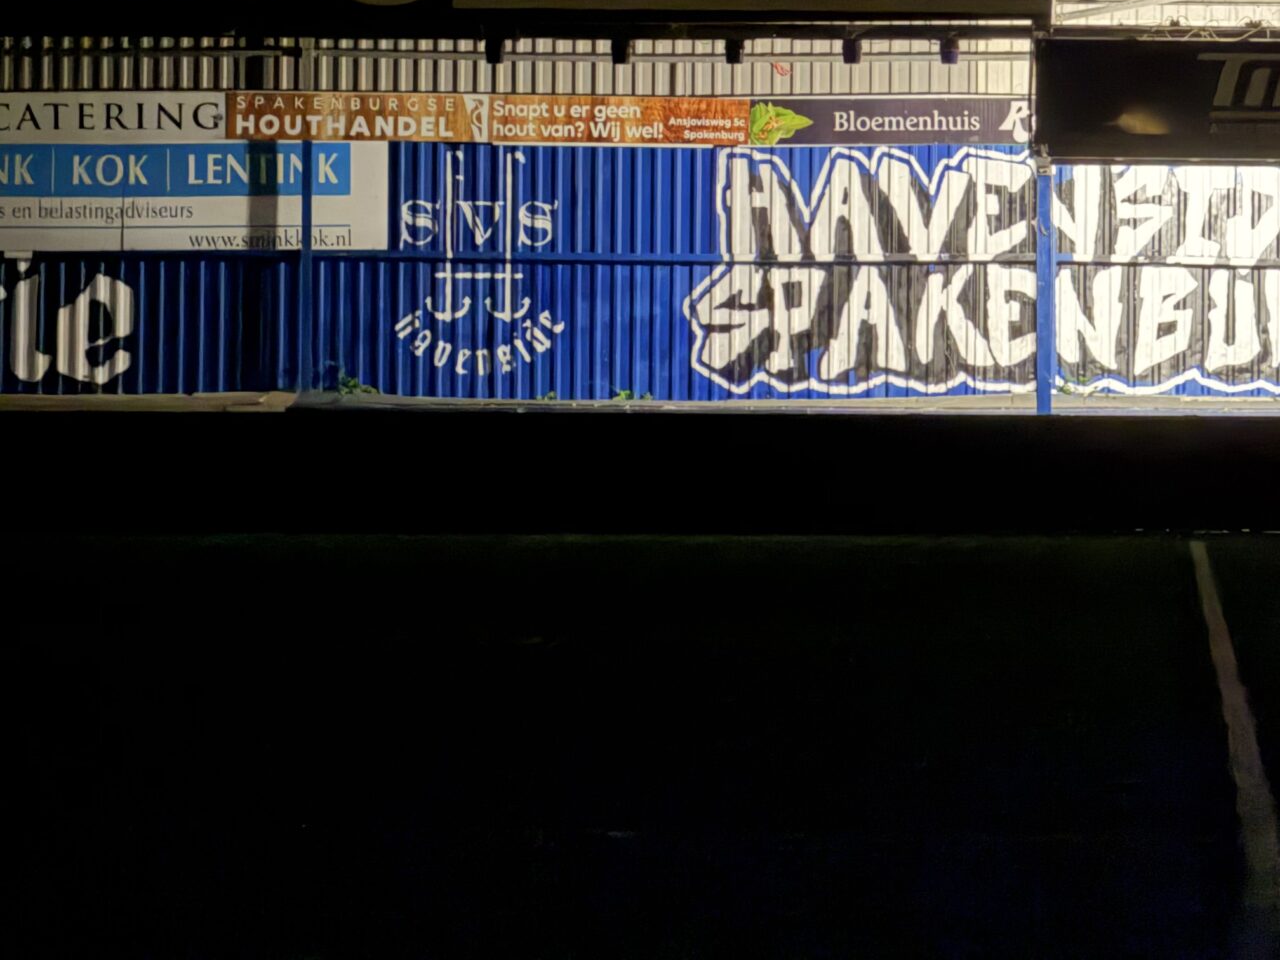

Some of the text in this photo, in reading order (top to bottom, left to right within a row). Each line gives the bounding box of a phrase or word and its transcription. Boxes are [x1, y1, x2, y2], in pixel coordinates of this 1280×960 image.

[236, 95, 456, 112] SPAKENBURGSE
[492, 101, 641, 125] Snapt u er geen
[235, 114, 455, 138] HOUTHANDEL
[492, 121, 664, 142] hout van? Wij wel!
[834, 111, 980, 133] Bloemenhuis
[71, 154, 149, 186] KOK
[187, 153, 340, 186] LENTINK
[12, 206, 32, 220] en
[38, 200, 194, 225] belastingadviseurs
